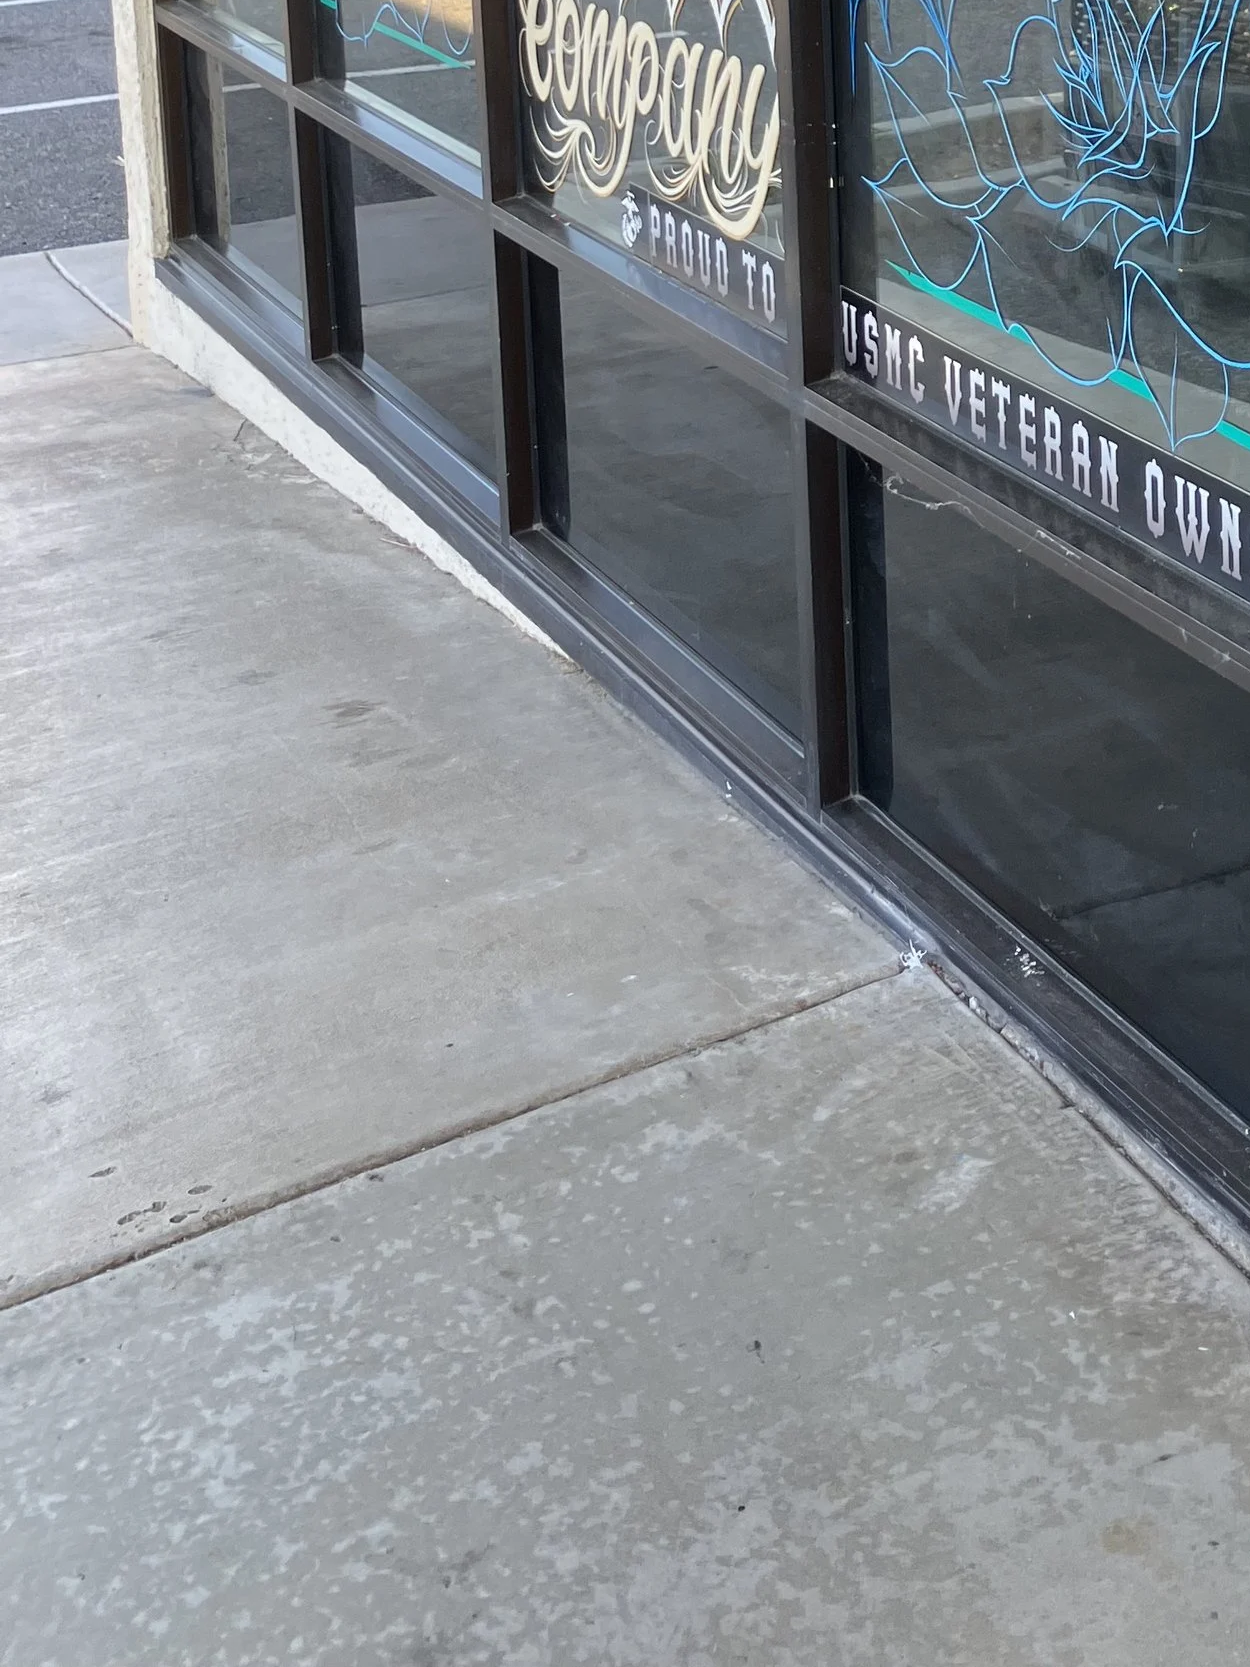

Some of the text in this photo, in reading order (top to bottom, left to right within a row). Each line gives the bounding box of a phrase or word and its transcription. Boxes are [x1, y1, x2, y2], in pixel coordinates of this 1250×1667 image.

[650, 204, 776, 324] PROUD TO
[841, 300, 927, 404] USMC
[944, 356, 1120, 512] VETERAN
